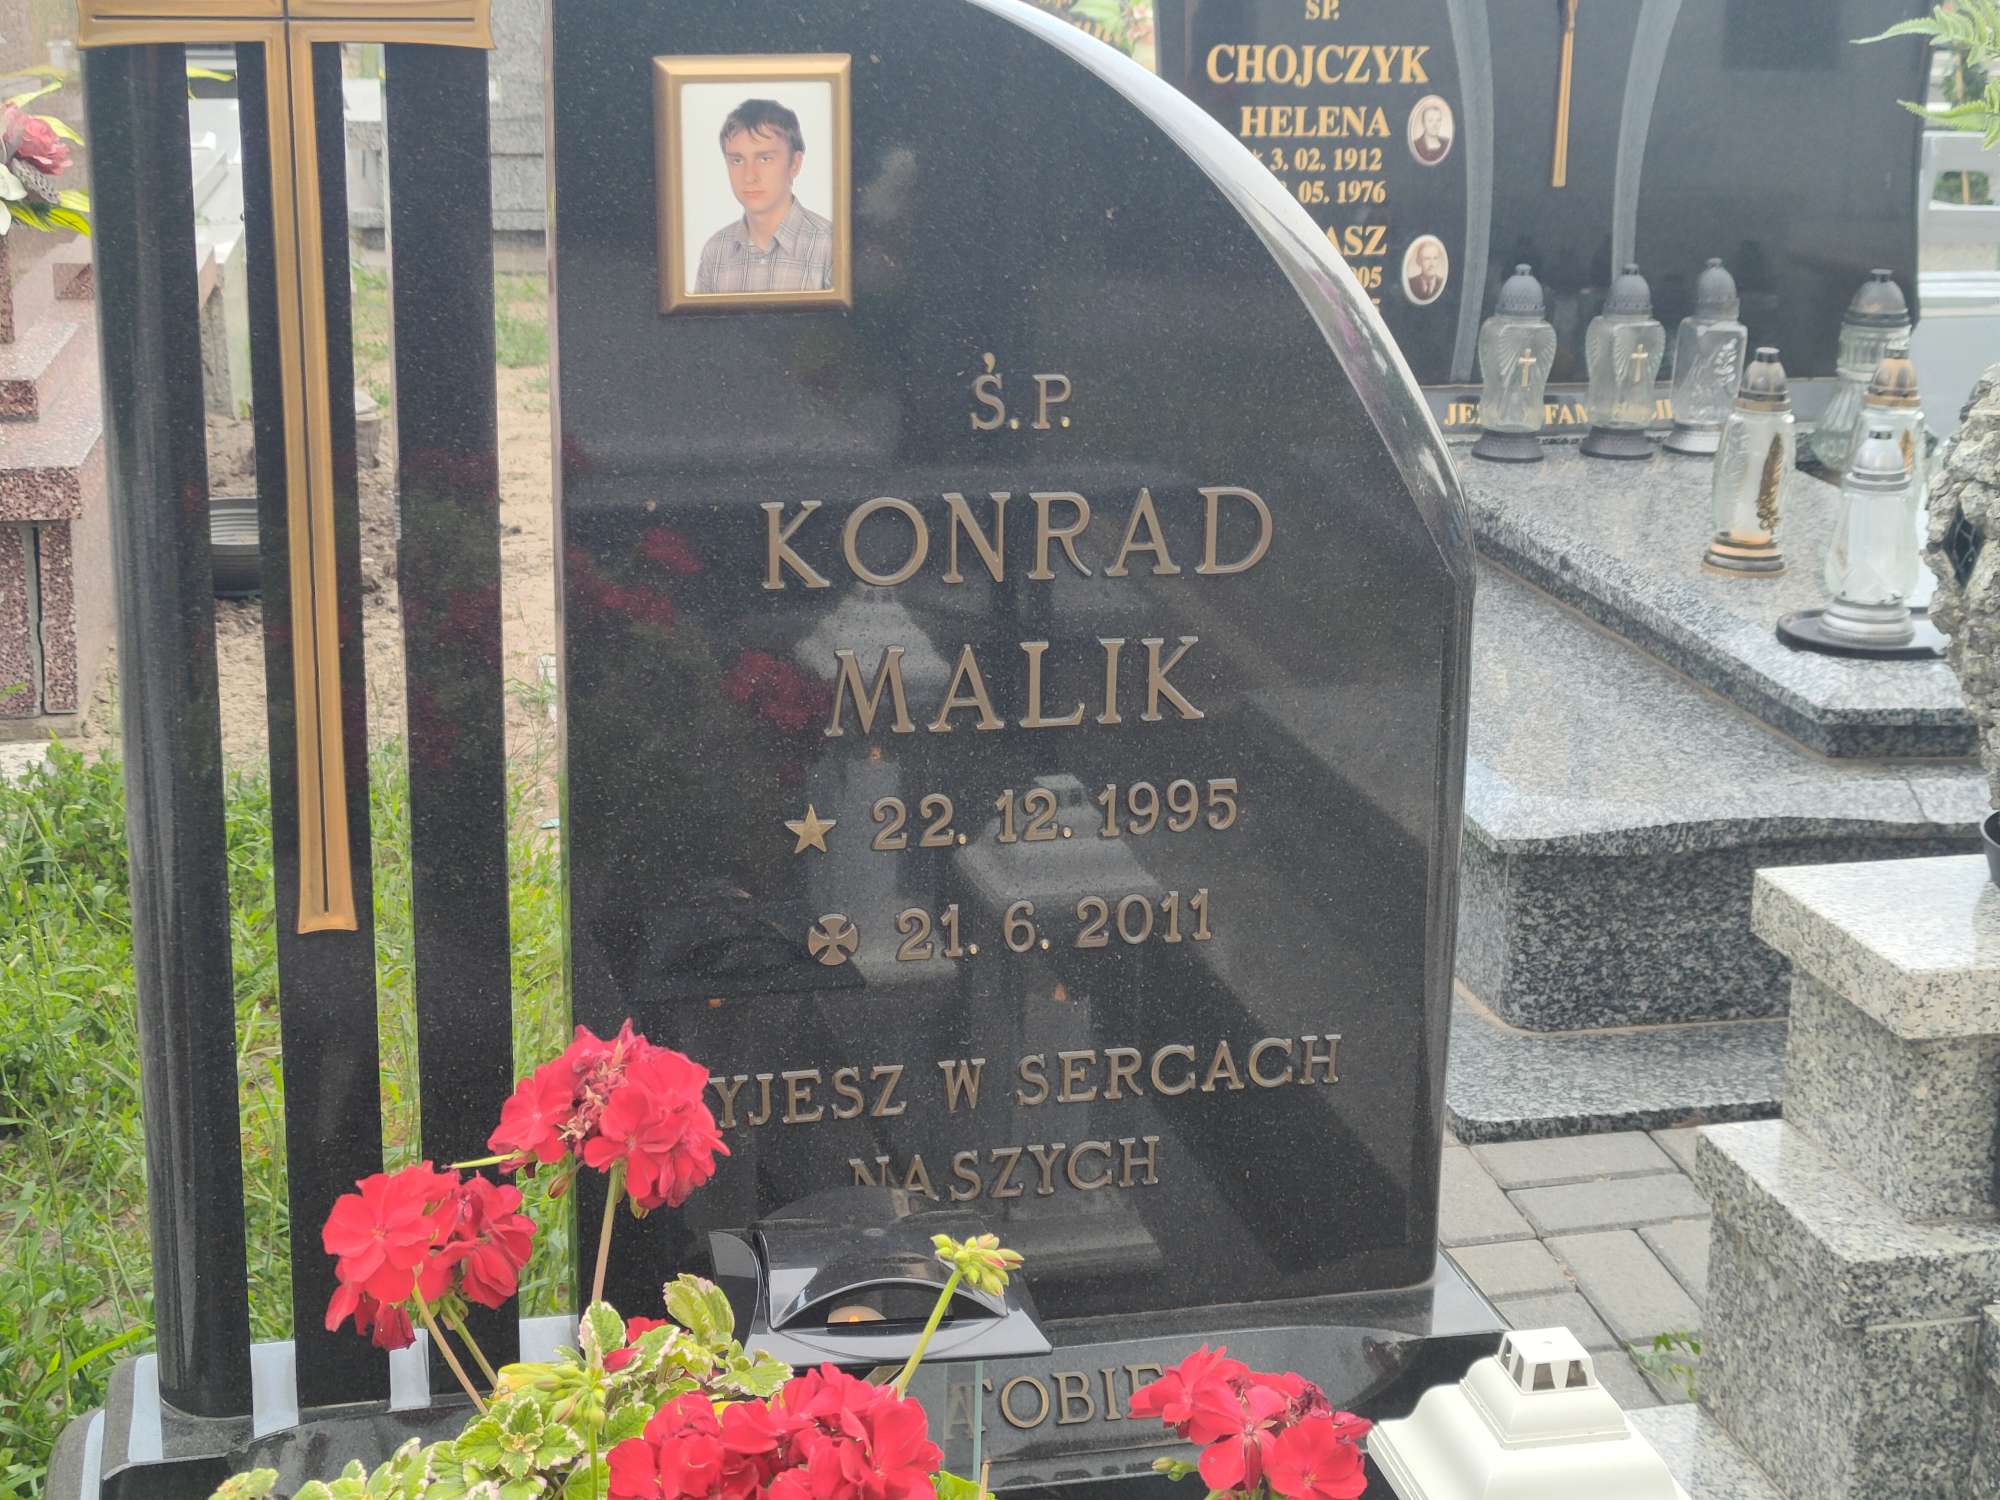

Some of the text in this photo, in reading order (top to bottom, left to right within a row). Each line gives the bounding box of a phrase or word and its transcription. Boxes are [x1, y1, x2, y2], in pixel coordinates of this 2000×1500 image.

[1206, 43, 1431, 88] CHOJCZYK
[1239, 105, 1391, 138] HELENA
[1294, 147, 1327, 172] 02.
[1333, 147, 1383, 172] 1912
[1337, 180, 1388, 204] 1976
[760, 486, 1274, 590] KONRAD
[823, 635, 1205, 737] MALIK
[871, 777, 1238, 850] 22. 12. 1995
[895, 888, 1212, 961] 21. 6. 2011
[706, 1033, 1343, 1129] YJESZ W SERCACH
[848, 1134, 1160, 1202] NASZYCH
